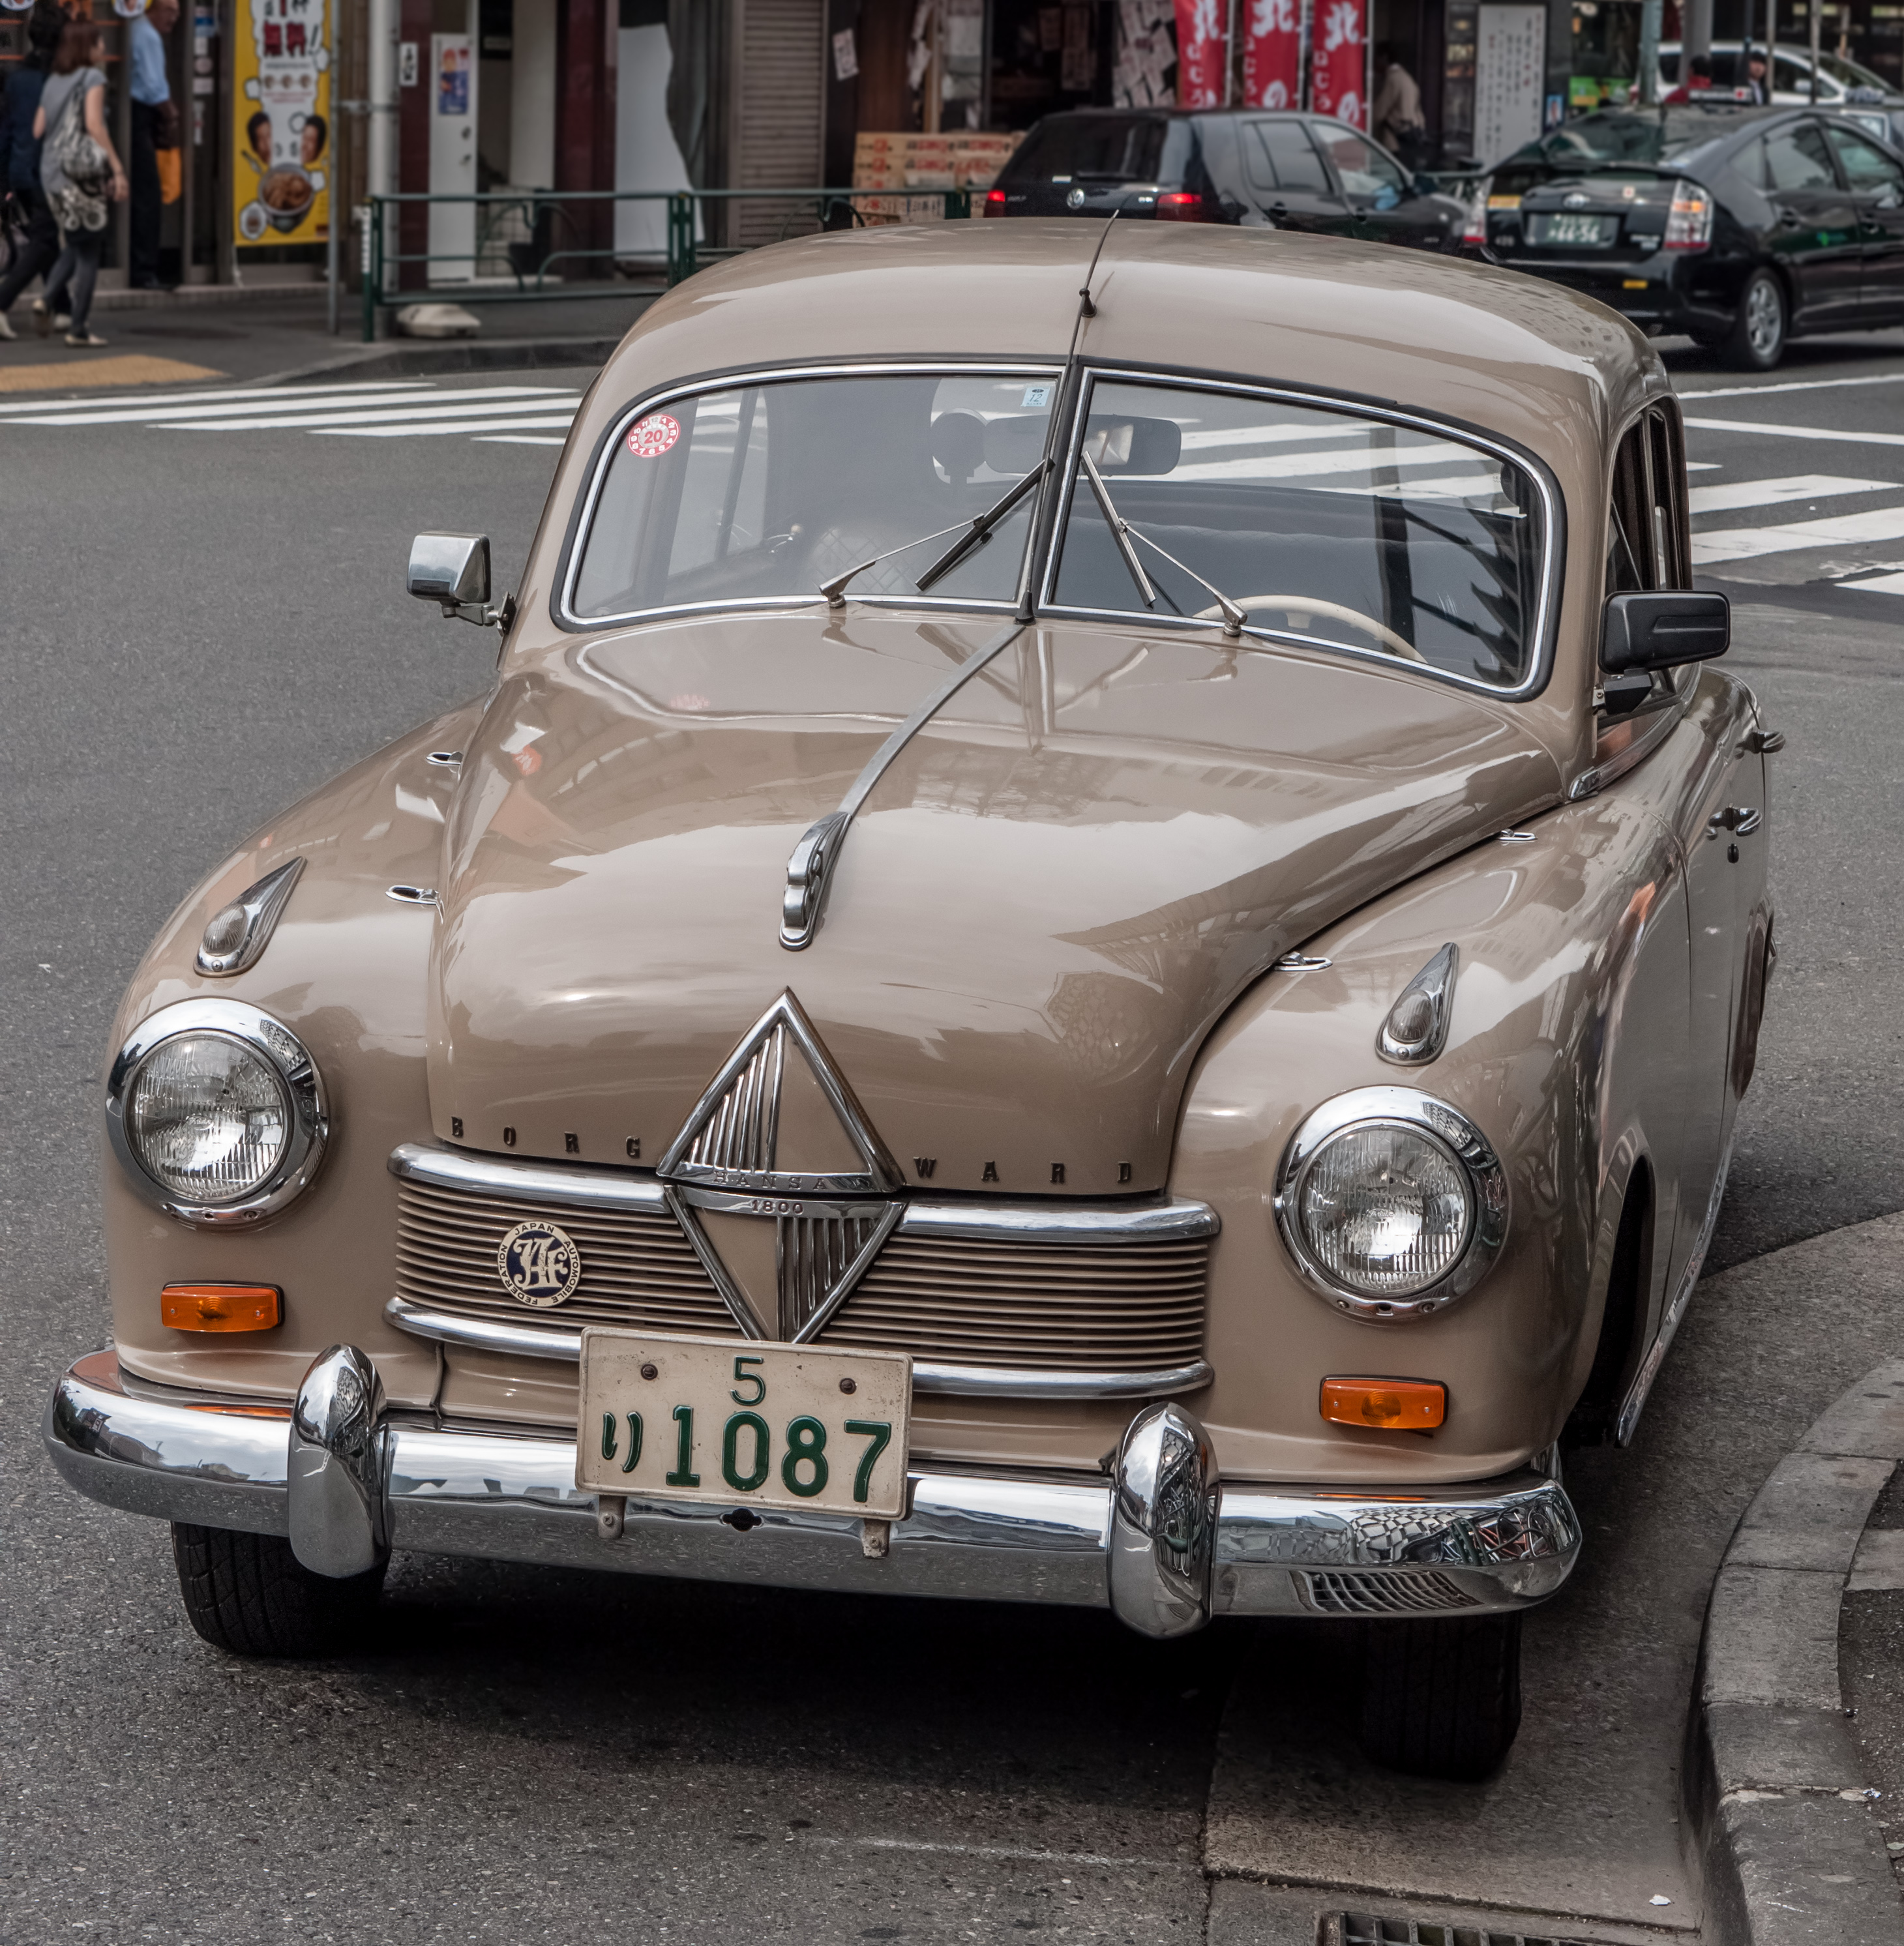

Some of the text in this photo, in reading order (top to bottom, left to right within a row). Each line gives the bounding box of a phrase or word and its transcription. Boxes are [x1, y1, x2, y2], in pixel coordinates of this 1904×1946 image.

[644, 429, 663, 445] 20
[451, 1115, 1132, 1184] BORG WARD
[713, 1172, 827, 1191] HANSA
[514, 1222, 555, 1235] JAPAN
[751, 1199, 804, 1215] 1800
[499, 1245, 539, 1305] FEDERATION
[550, 1240, 579, 1304] AUTOMOBILE
[730, 1356, 766, 1406] 5
[601, 1404, 893, 1503] り 1087
